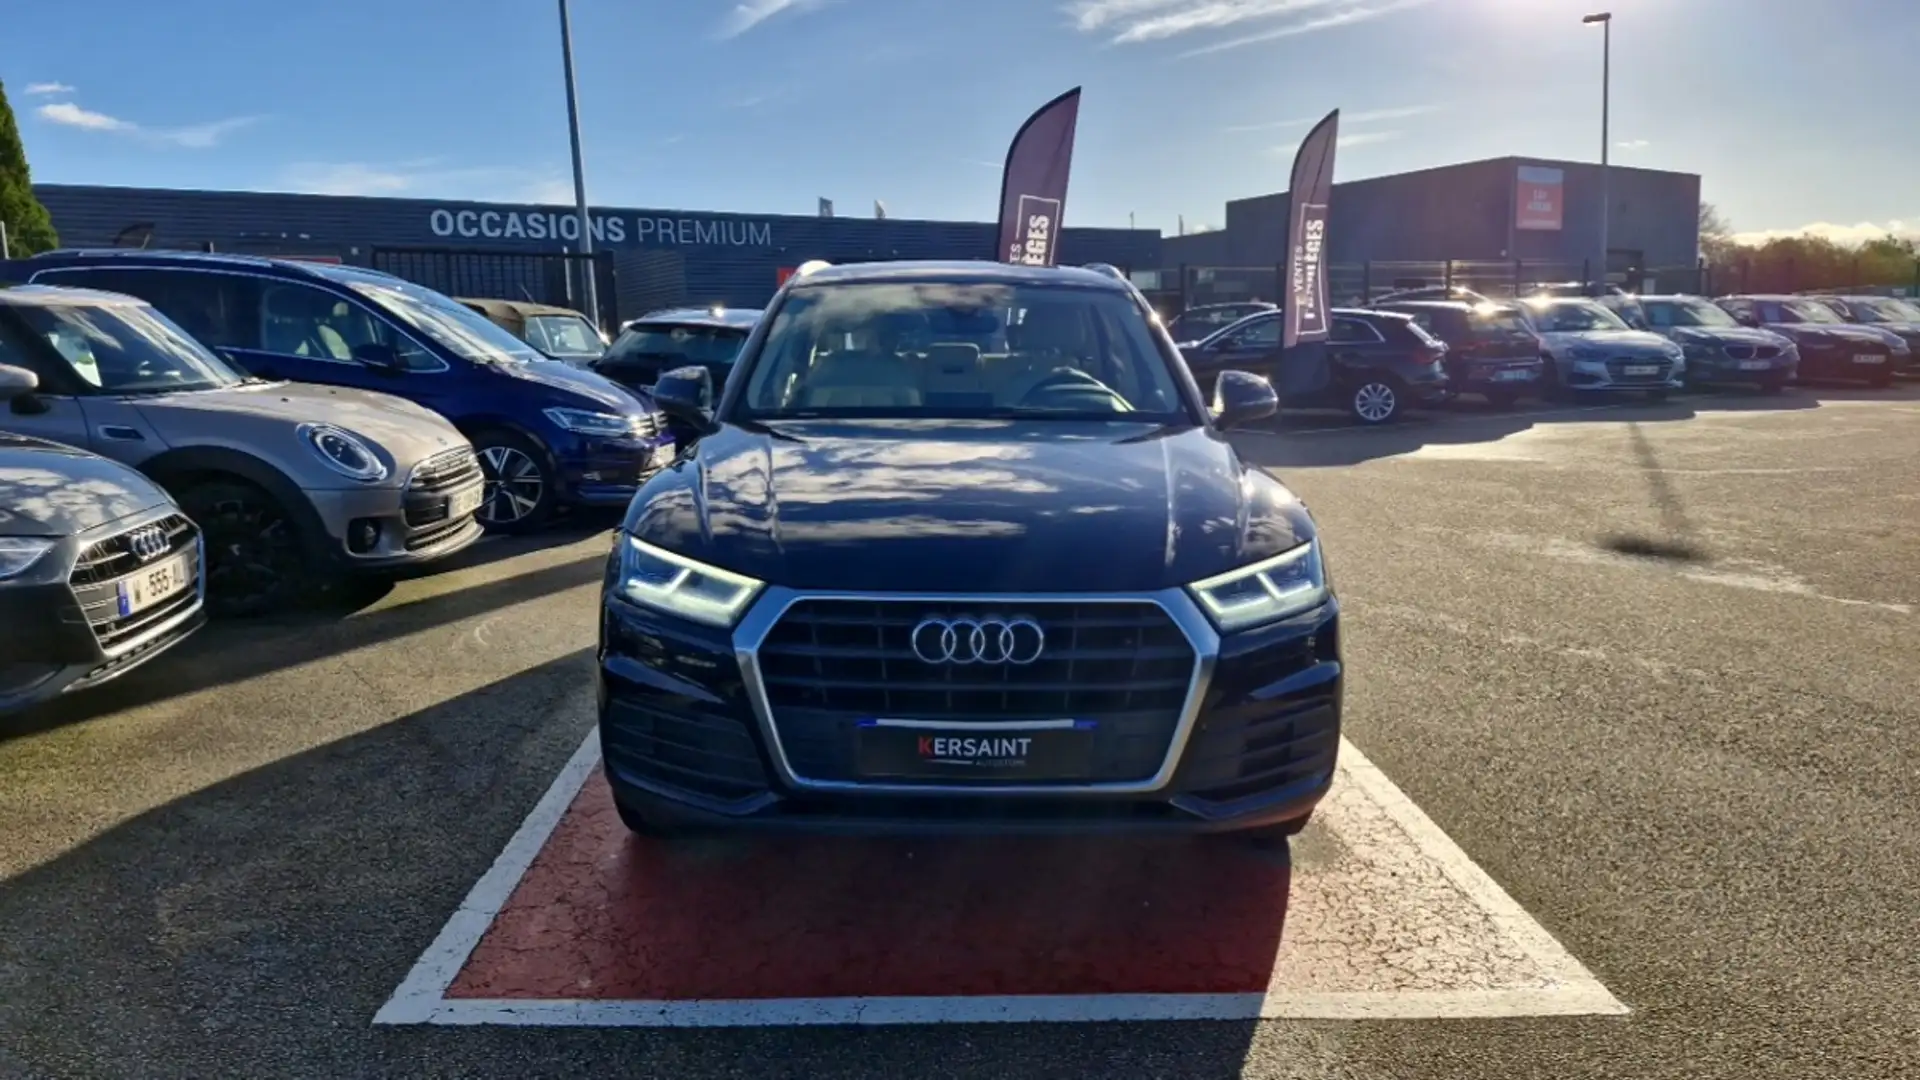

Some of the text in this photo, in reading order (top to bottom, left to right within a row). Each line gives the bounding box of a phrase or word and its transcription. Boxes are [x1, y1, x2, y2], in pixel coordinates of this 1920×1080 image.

[430, 209, 771, 246] OCCASIONS PREMIUM
[918, 737, 1032, 757] KERSAINT
